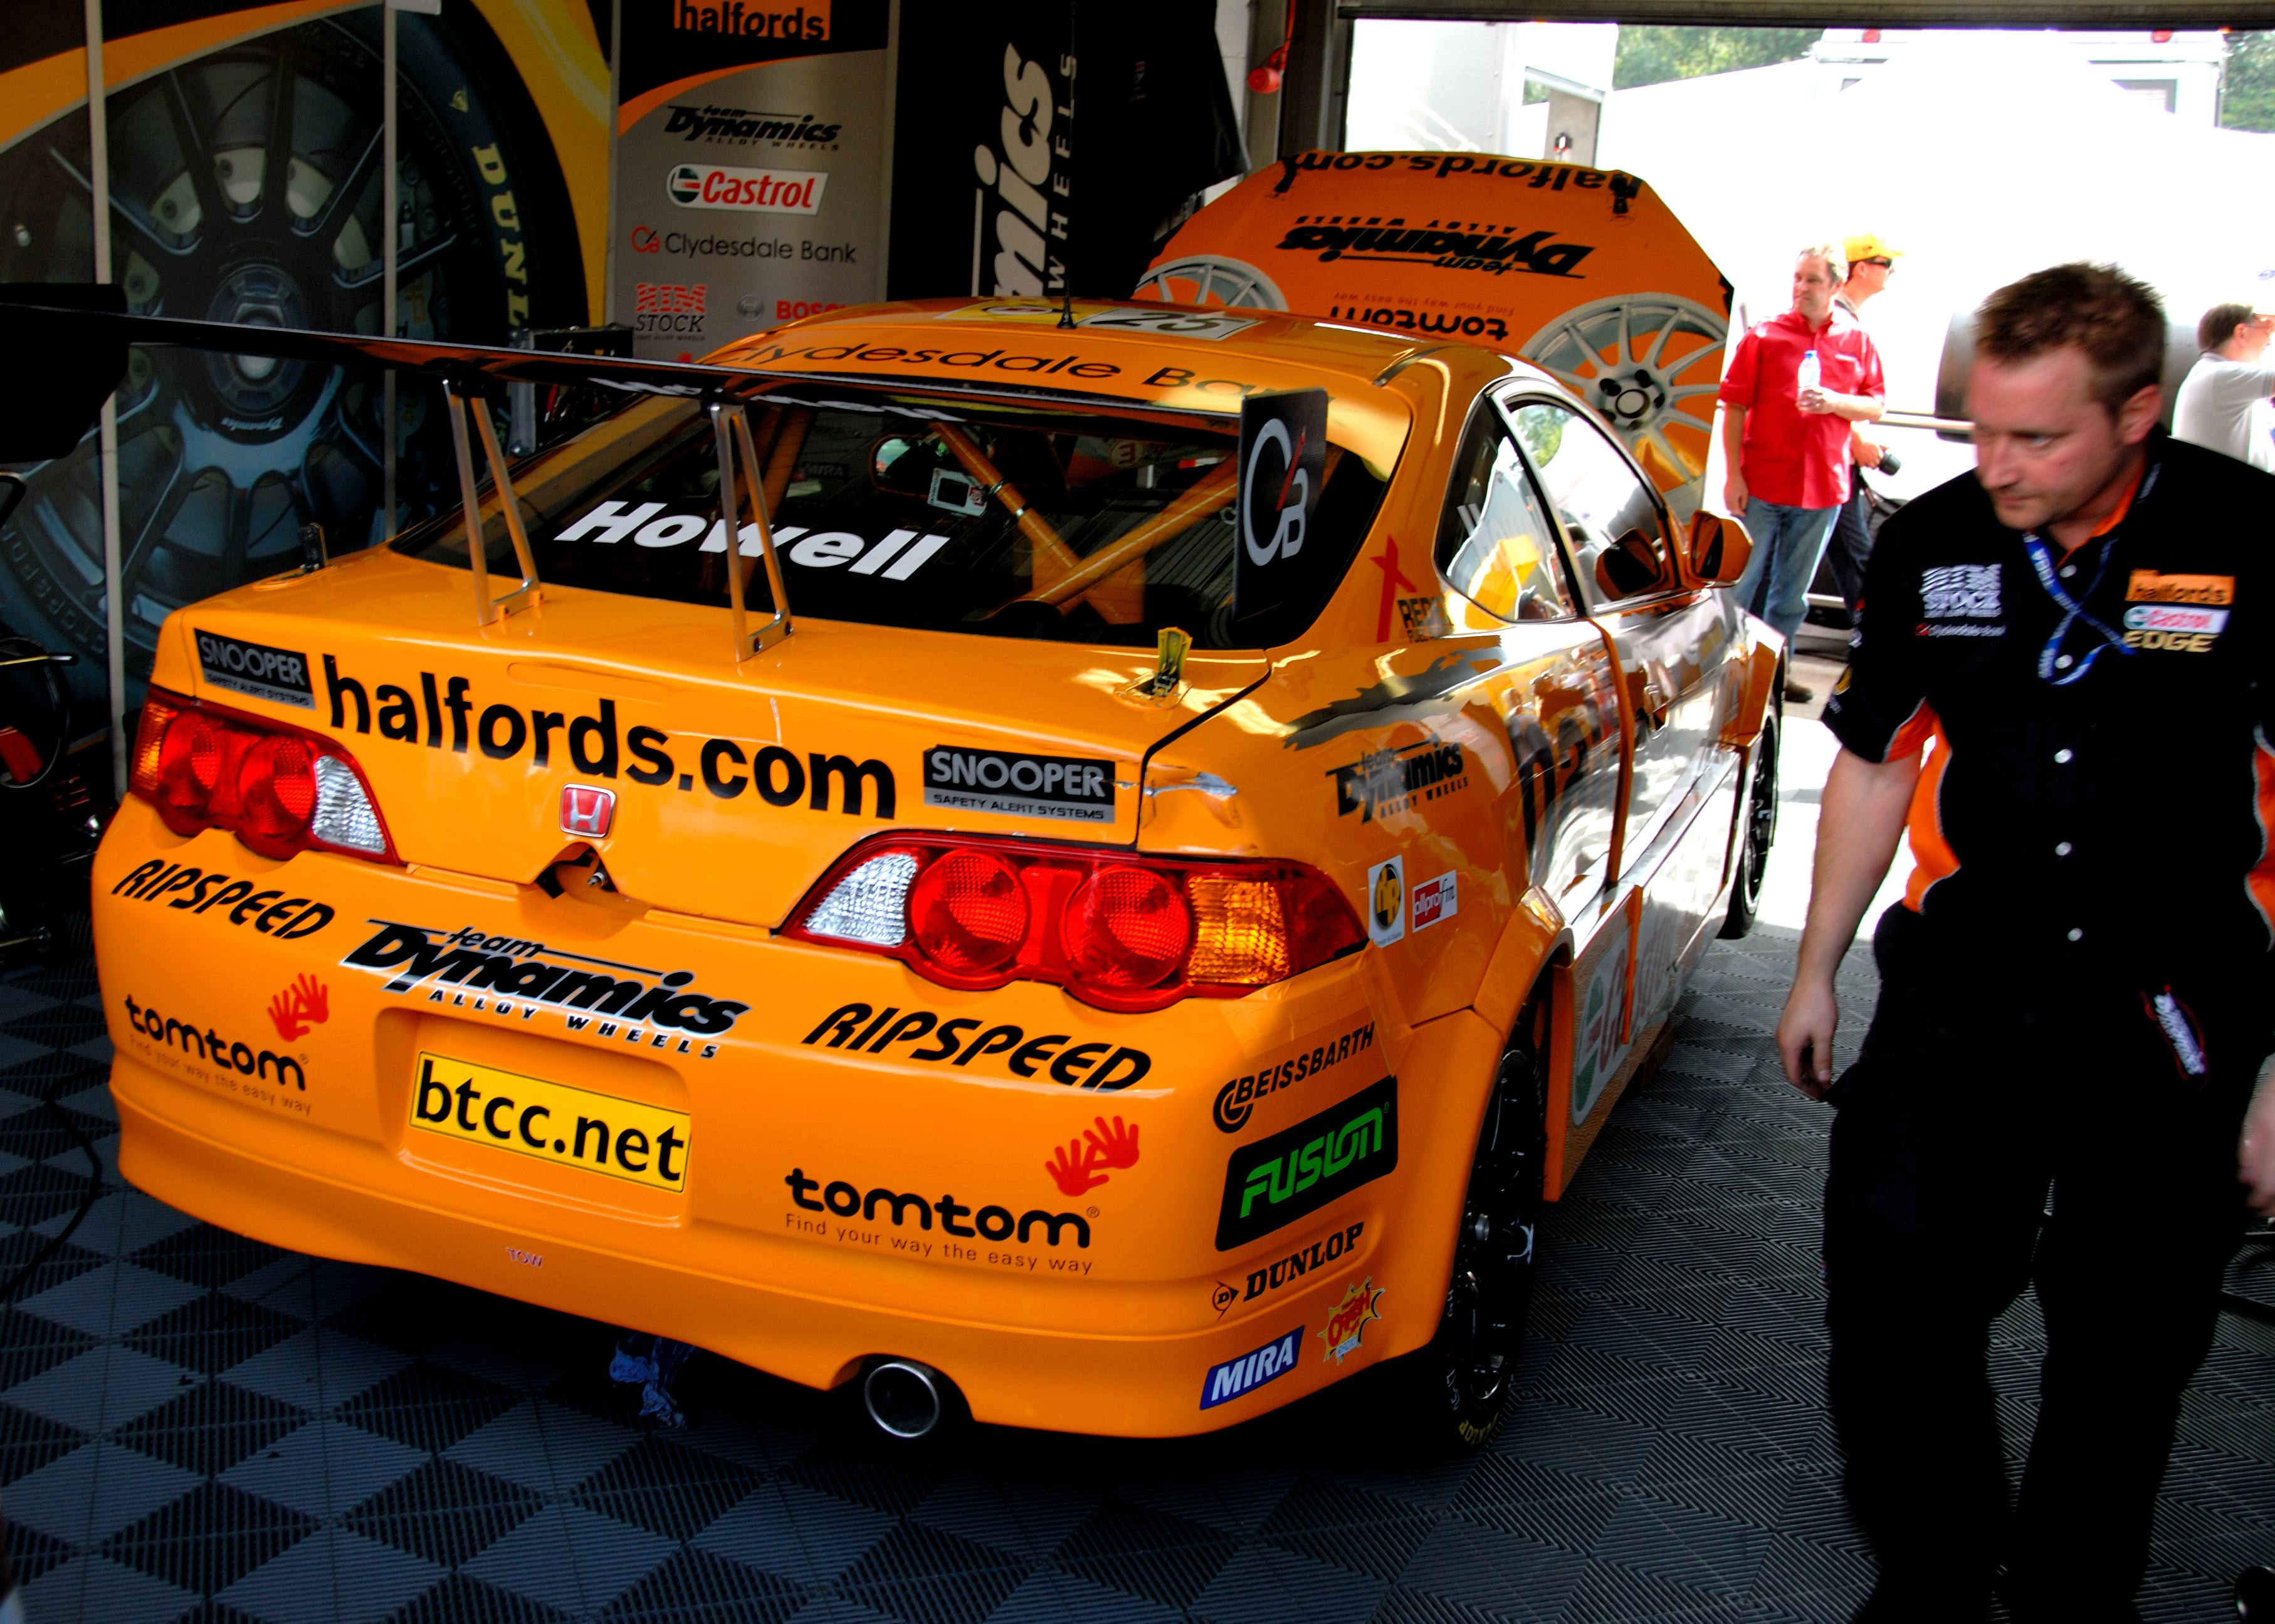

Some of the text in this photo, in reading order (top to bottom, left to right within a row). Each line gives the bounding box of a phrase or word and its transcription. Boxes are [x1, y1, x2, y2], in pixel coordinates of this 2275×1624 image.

[680, 0, 825, 41] halfords
[665, 106, 842, 142] Dynamics
[703, 105, 747, 117] team
[772, 141, 840, 151] WHEELS
[703, 171, 815, 208] Castrol
[471, 142, 530, 328] DUNL
[665, 233, 856, 263] Clydesdale Bank
[1276, 224, 1595, 278] Dynamics
[1434, 256, 1519, 276] team
[635, 315, 704, 332] STOCK
[554, 500, 951, 581] Howell
[199, 636, 306, 686] SNOOPER
[2122, 630, 2220, 652] EDGE
[322, 652, 896, 820] halfords.com
[931, 751, 1106, 798] SNOOPER
[933, 794, 1105, 819] SAFETY ALERT SYSTEMS
[111, 859, 336, 940] RIPSPEED
[446, 925, 546, 959] team
[337, 918, 754, 1039] Dynamics
[125, 993, 306, 1092] tomtom
[428, 988, 721, 1060] ALLOY WHEELS
[801, 1001, 1152, 1093] RIPSPEED
[1233, 1021, 1375, 1105] BEISSBARTH
[243, 1084, 275, 1106] easy
[416, 1057, 685, 1182] btcc.net
[784, 1167, 1091, 1250] tomtom
[505, 1247, 544, 1269] TOW
[785, 1212, 1094, 1277] Find your way the easy way
[1243, 1221, 1365, 1302] DUNLOP
[1211, 1335, 1294, 1401] MIRA
